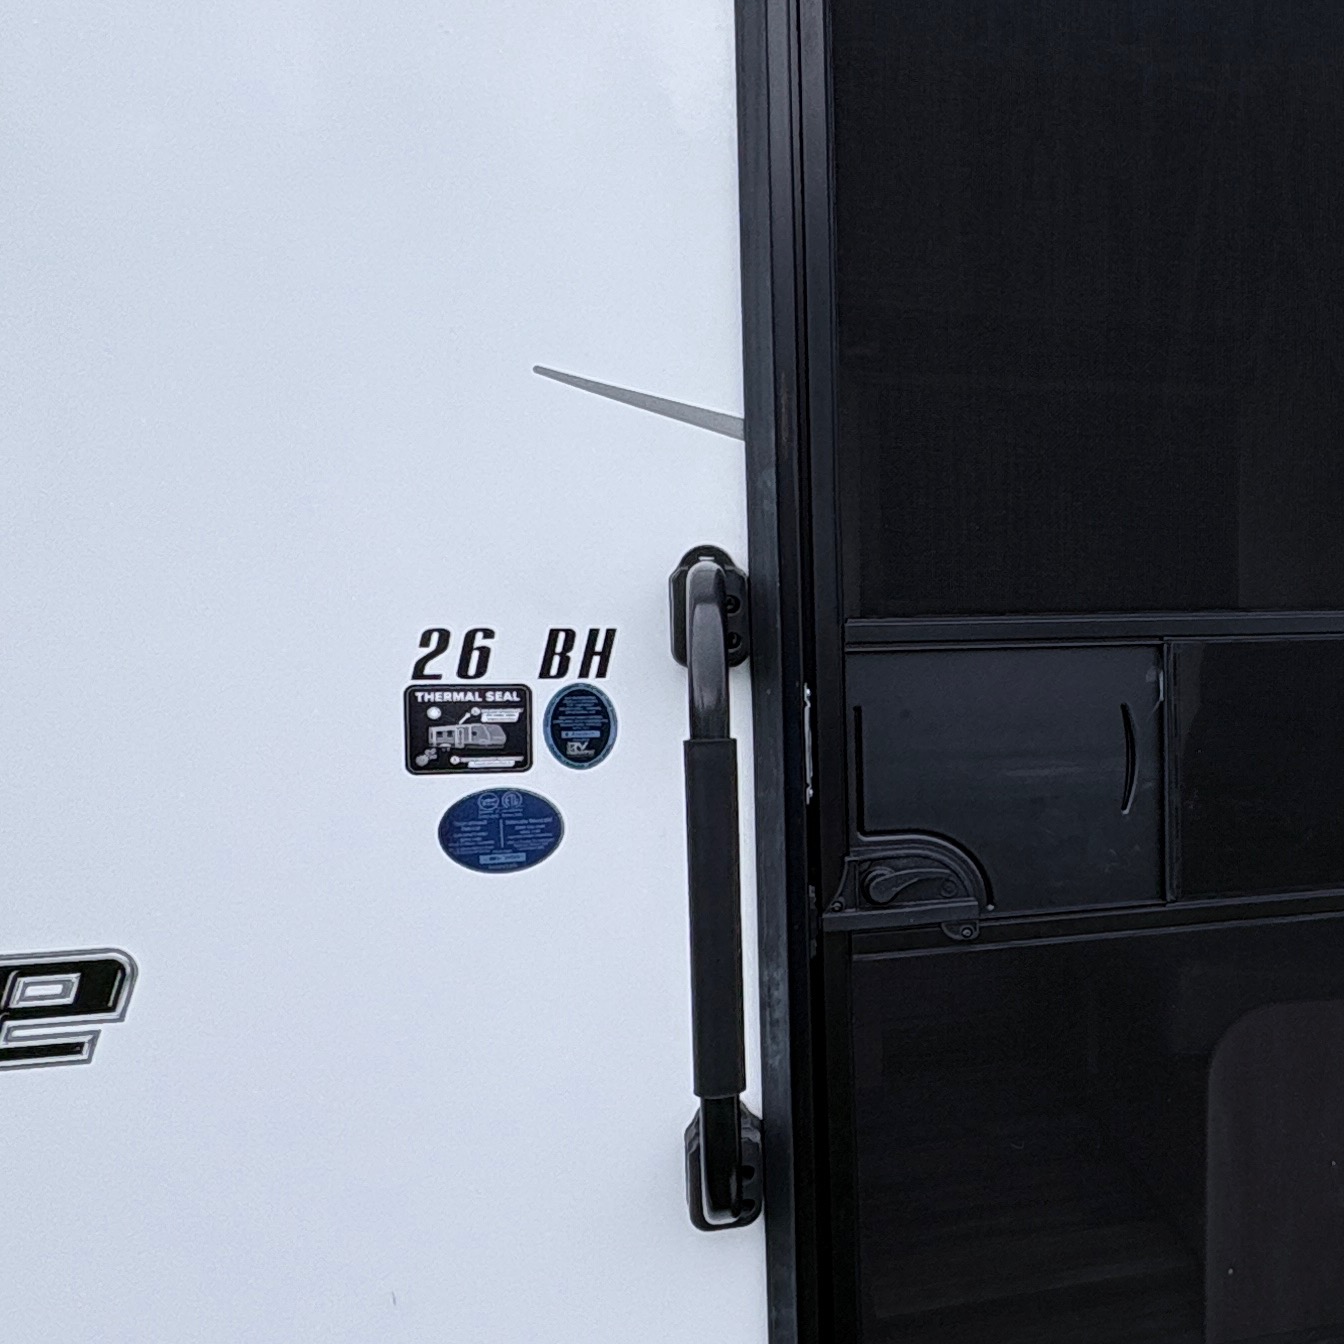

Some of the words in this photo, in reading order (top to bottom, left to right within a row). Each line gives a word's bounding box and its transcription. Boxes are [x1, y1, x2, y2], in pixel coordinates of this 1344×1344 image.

[411, 627, 496, 680] 26
[537, 627, 617, 680] BH
[414, 691, 483, 703] THERMAL
[485, 690, 521, 702] SEAL
